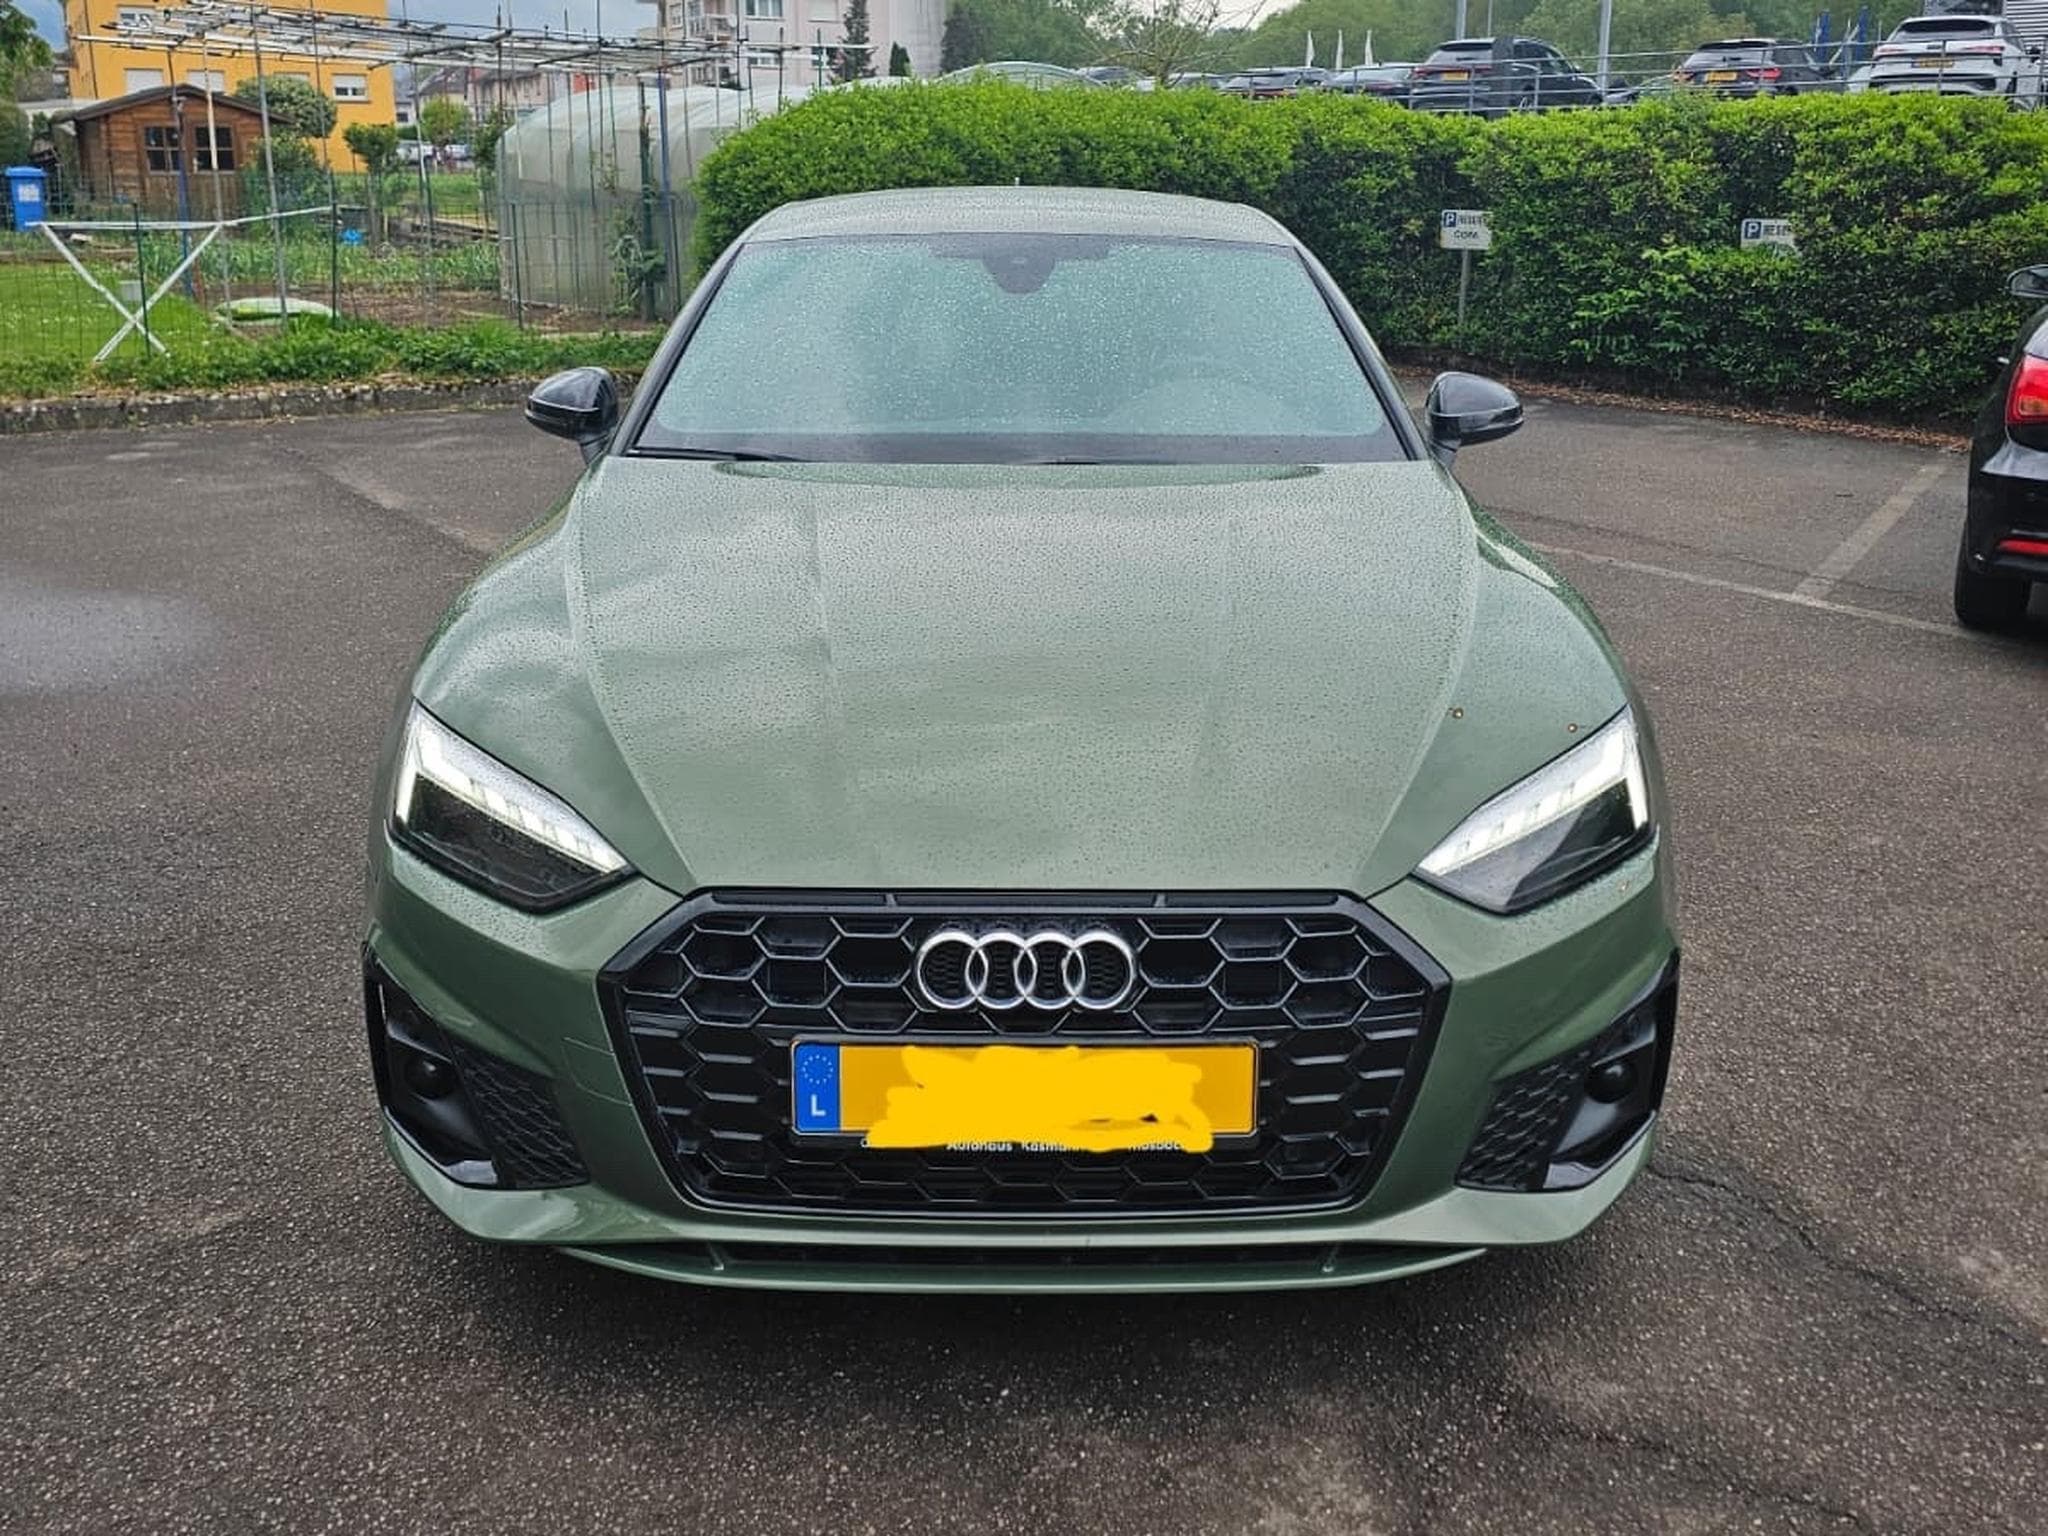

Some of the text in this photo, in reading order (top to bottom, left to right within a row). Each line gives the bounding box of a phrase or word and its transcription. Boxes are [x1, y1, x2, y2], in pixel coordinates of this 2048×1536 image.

[1446, 213, 1455, 227] P
[1747, 222, 1759, 238] P
[811, 1094, 826, 1116] L
